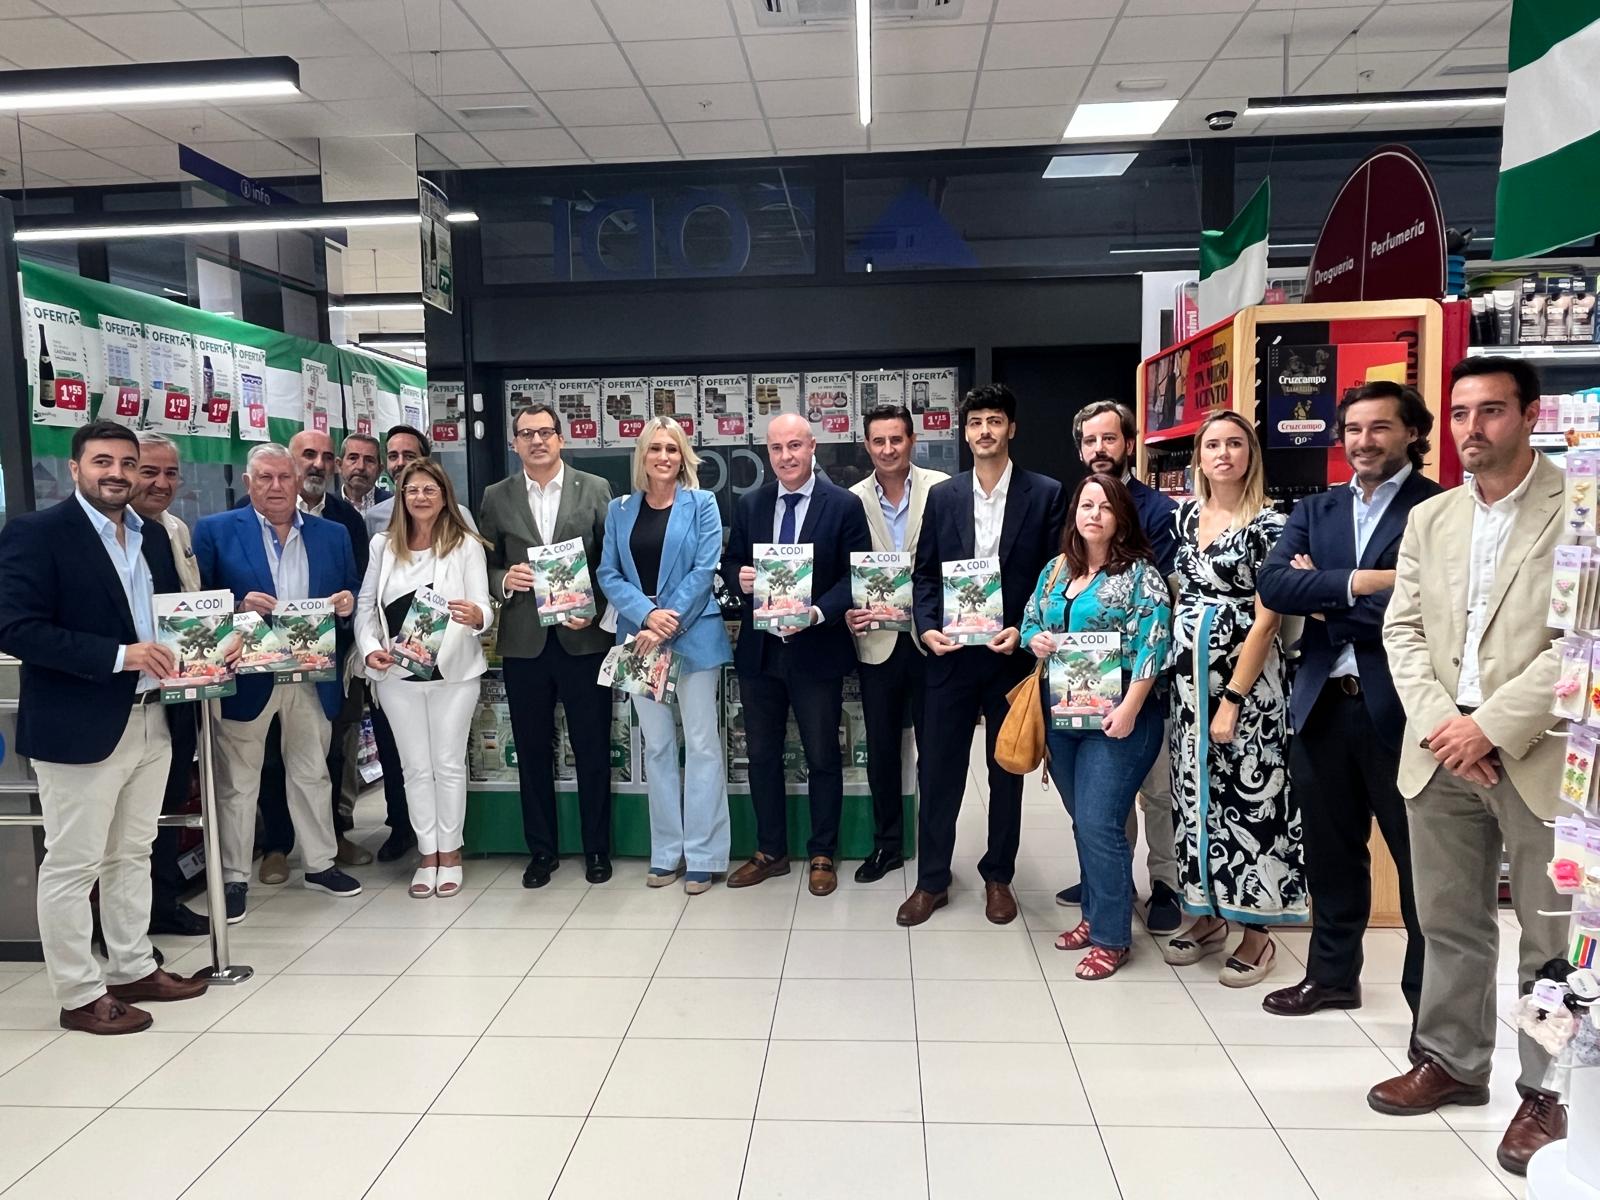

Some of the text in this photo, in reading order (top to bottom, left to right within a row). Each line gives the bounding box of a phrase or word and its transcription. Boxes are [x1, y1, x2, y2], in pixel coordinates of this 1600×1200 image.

[252, 184, 270, 206] info
[1371, 218, 1425, 259] Perfumería
[1314, 256, 1354, 286] Droguería
[33, 306, 75, 326] OFERTA
[105, 321, 137, 337] OFERTA
[152, 331, 186, 347] OFERTA
[200, 341, 228, 355] OFERTA
[239, 349, 262, 361] OFERTA
[811, 375, 847, 383] OFERTA
[861, 374, 897, 382] OFERTA
[912, 372, 948, 380] OFERTA
[1278, 375, 1327, 384] Cruzcampo
[608, 381, 642, 389] OFERTA
[706, 378, 741, 386] OFERTA
[758, 377, 794, 385] OFERTA
[560, 382, 594, 390] OFERTA
[1281, 423, 1323, 431] Cruzcampo
[553, 541, 575, 554] CODI
[780, 546, 804, 555] CODI
[877, 553, 900, 563] CODI
[966, 561, 989, 570] CODI
[195, 599, 223, 610] CODI
[300, 602, 325, 610] CODI
[1080, 635, 1108, 644] CODI
